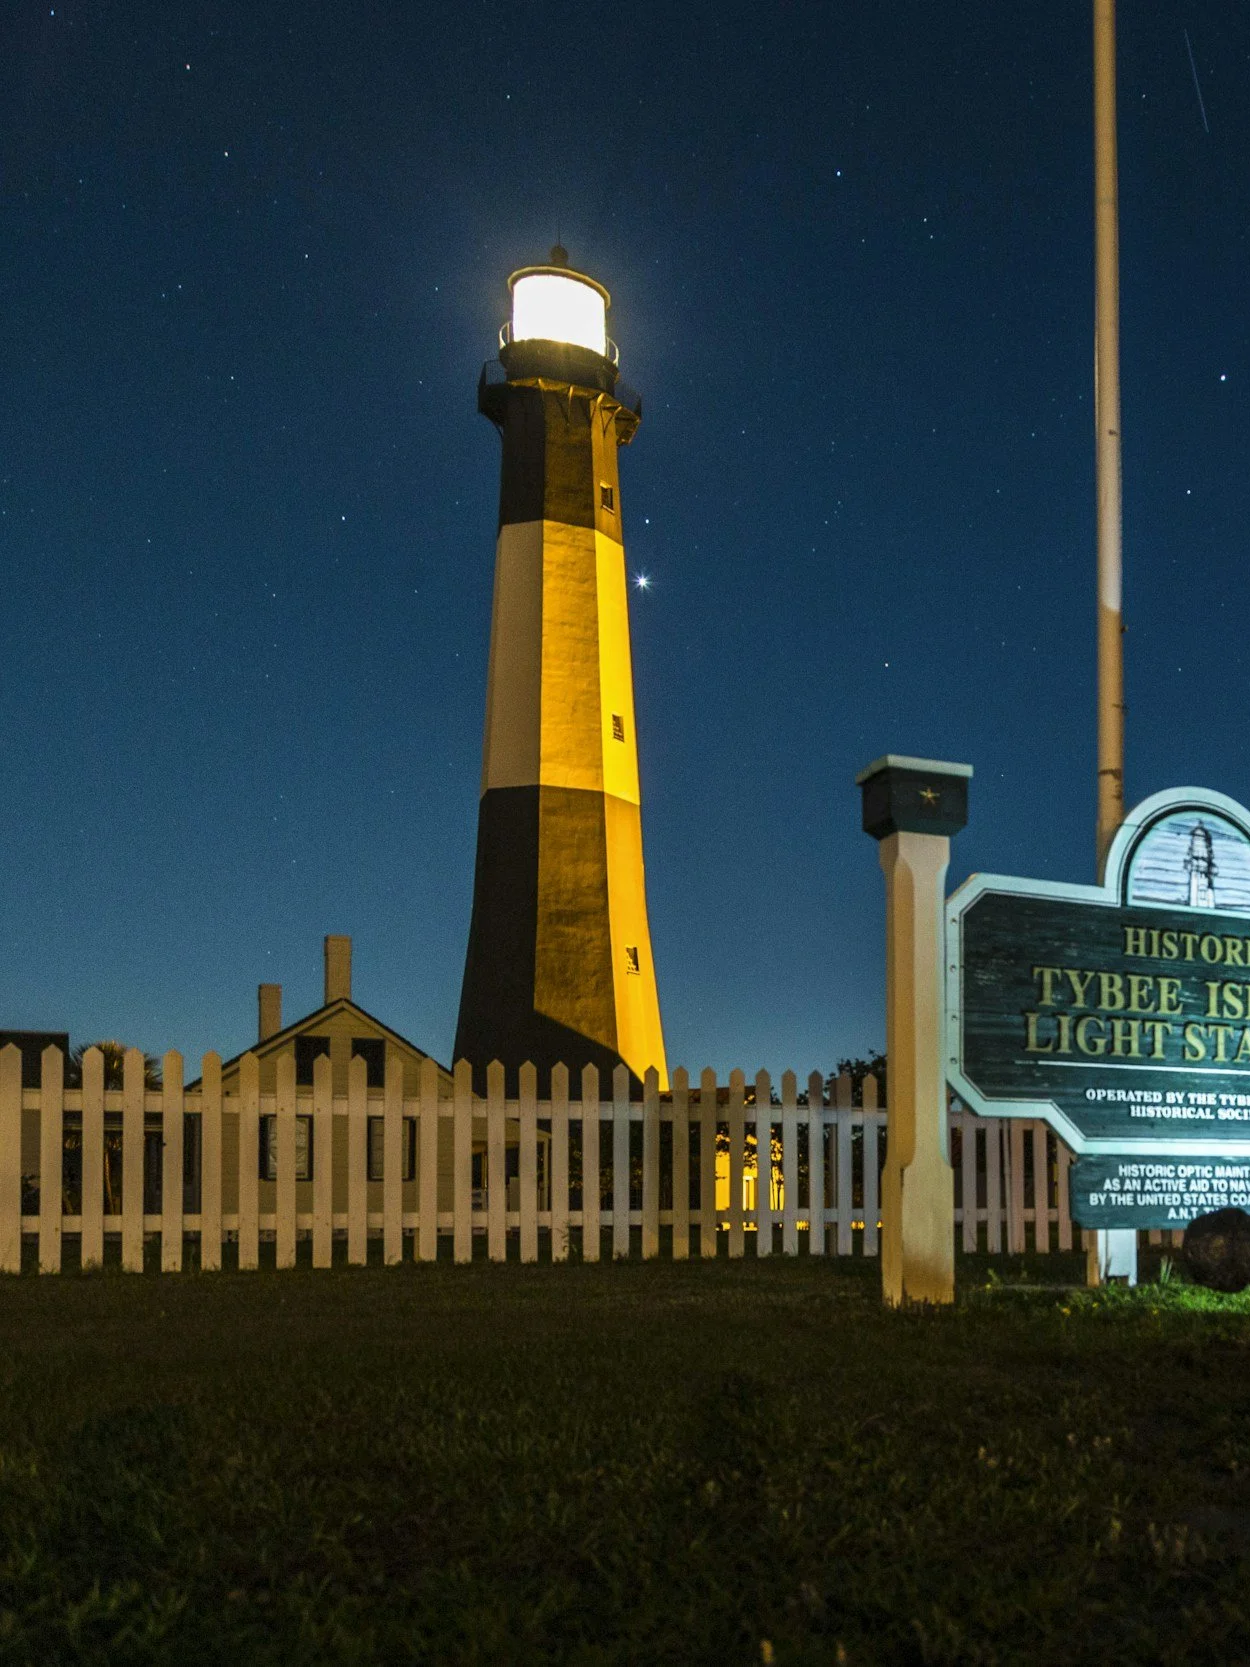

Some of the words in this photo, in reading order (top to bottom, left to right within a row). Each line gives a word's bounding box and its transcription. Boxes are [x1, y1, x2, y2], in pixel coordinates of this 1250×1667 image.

[1032, 966, 1184, 1015] TYBEE
[1024, 1012, 1172, 1060] LIGHT
[1085, 1088, 1162, 1103] OPERATED
[1165, 1091, 1184, 1104] BY
[1187, 1092, 1217, 1105] THE
[1130, 1104, 1215, 1120] HISTORICAL
[1118, 1164, 1175, 1178] HISTORIC
[1177, 1165, 1213, 1178] OPTIC
[1103, 1178, 1121, 1191] AS
[1123, 1178, 1141, 1191] AN
[1143, 1178, 1187, 1192] ACTIVE
[1189, 1179, 1210, 1192] AID
[1211, 1179, 1228, 1193] TO
[1089, 1192, 1107, 1206] BY
[1110, 1193, 1135, 1206] THE
[1137, 1193, 1181, 1206] UNITED
[1182, 1193, 1229, 1206] STATES
